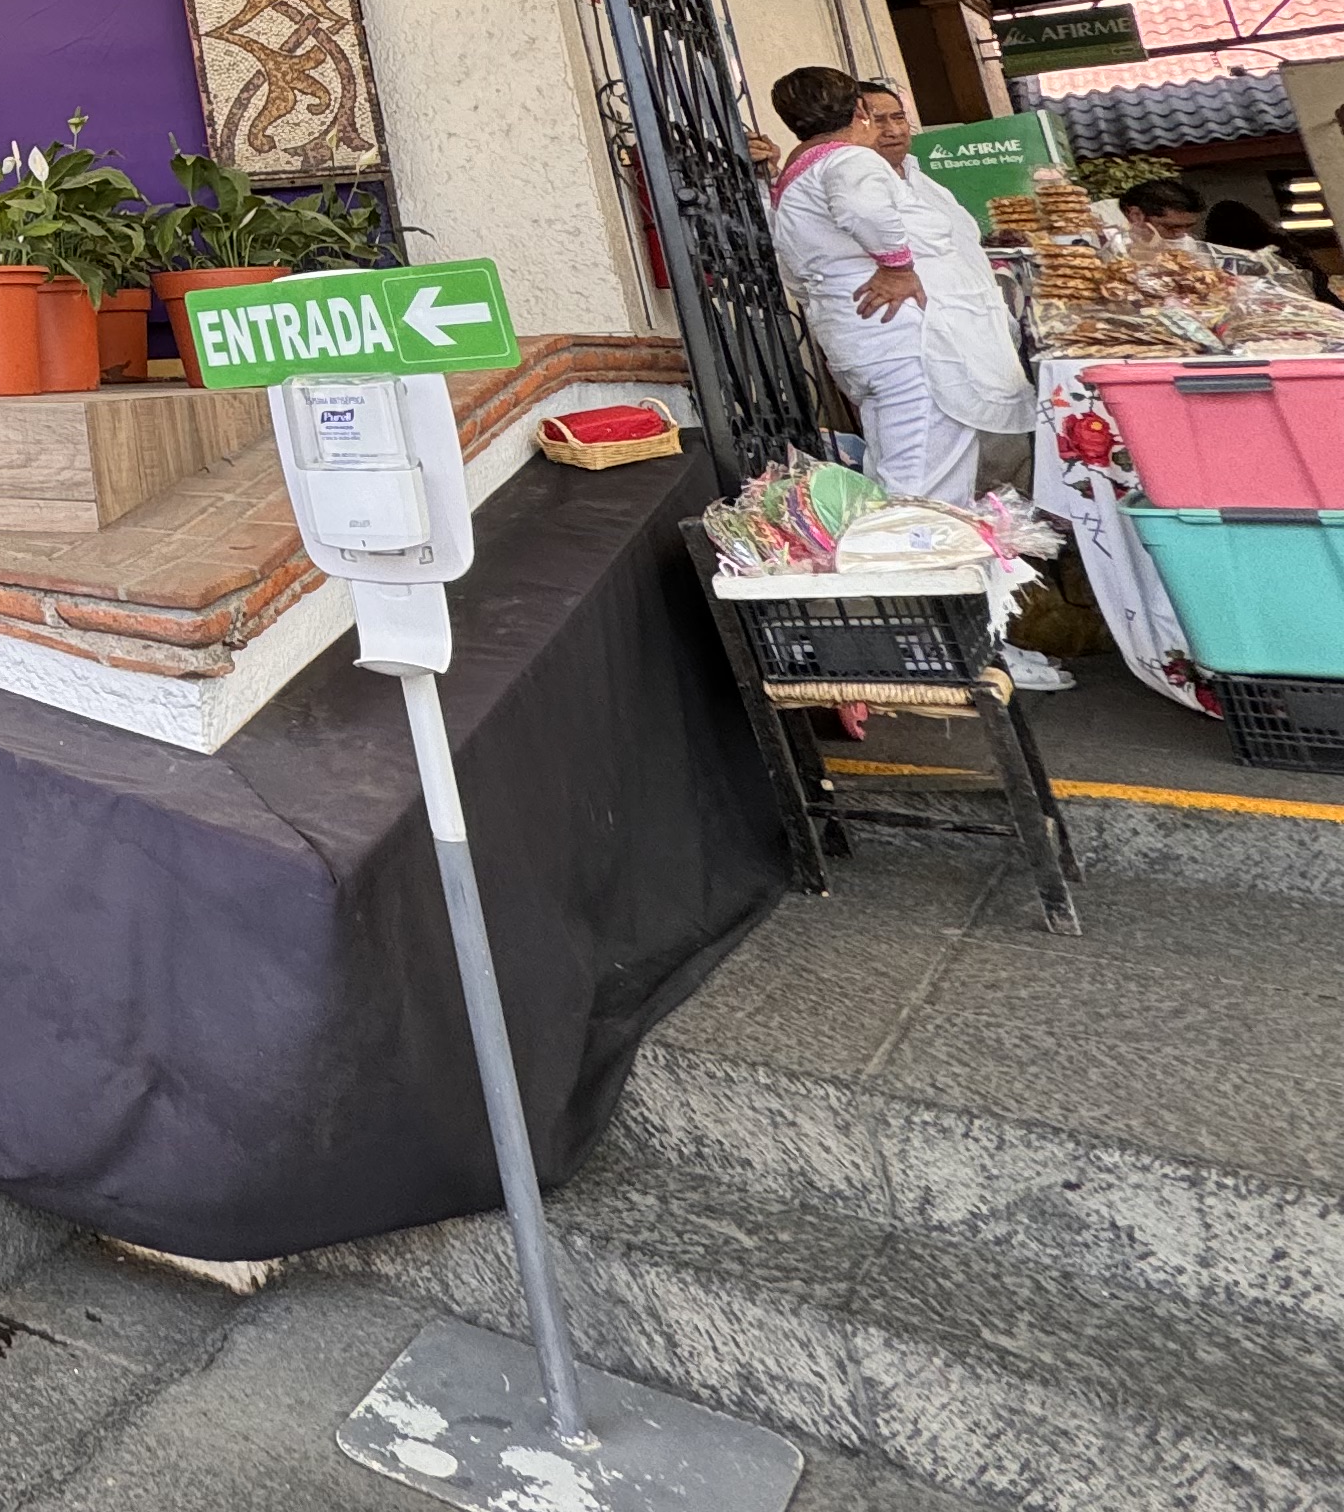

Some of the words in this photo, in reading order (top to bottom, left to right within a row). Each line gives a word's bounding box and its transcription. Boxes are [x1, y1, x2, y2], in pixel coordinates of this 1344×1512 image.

[1041, 17, 1132, 42] AFIRME
[957, 139, 1022, 156] AFIRME
[930, 160, 943, 169] El
[944, 158, 980, 168] Banco
[982, 156, 997, 165] de
[999, 155, 1024, 164] Hoy
[197, 294, 394, 367] ENTRADA
